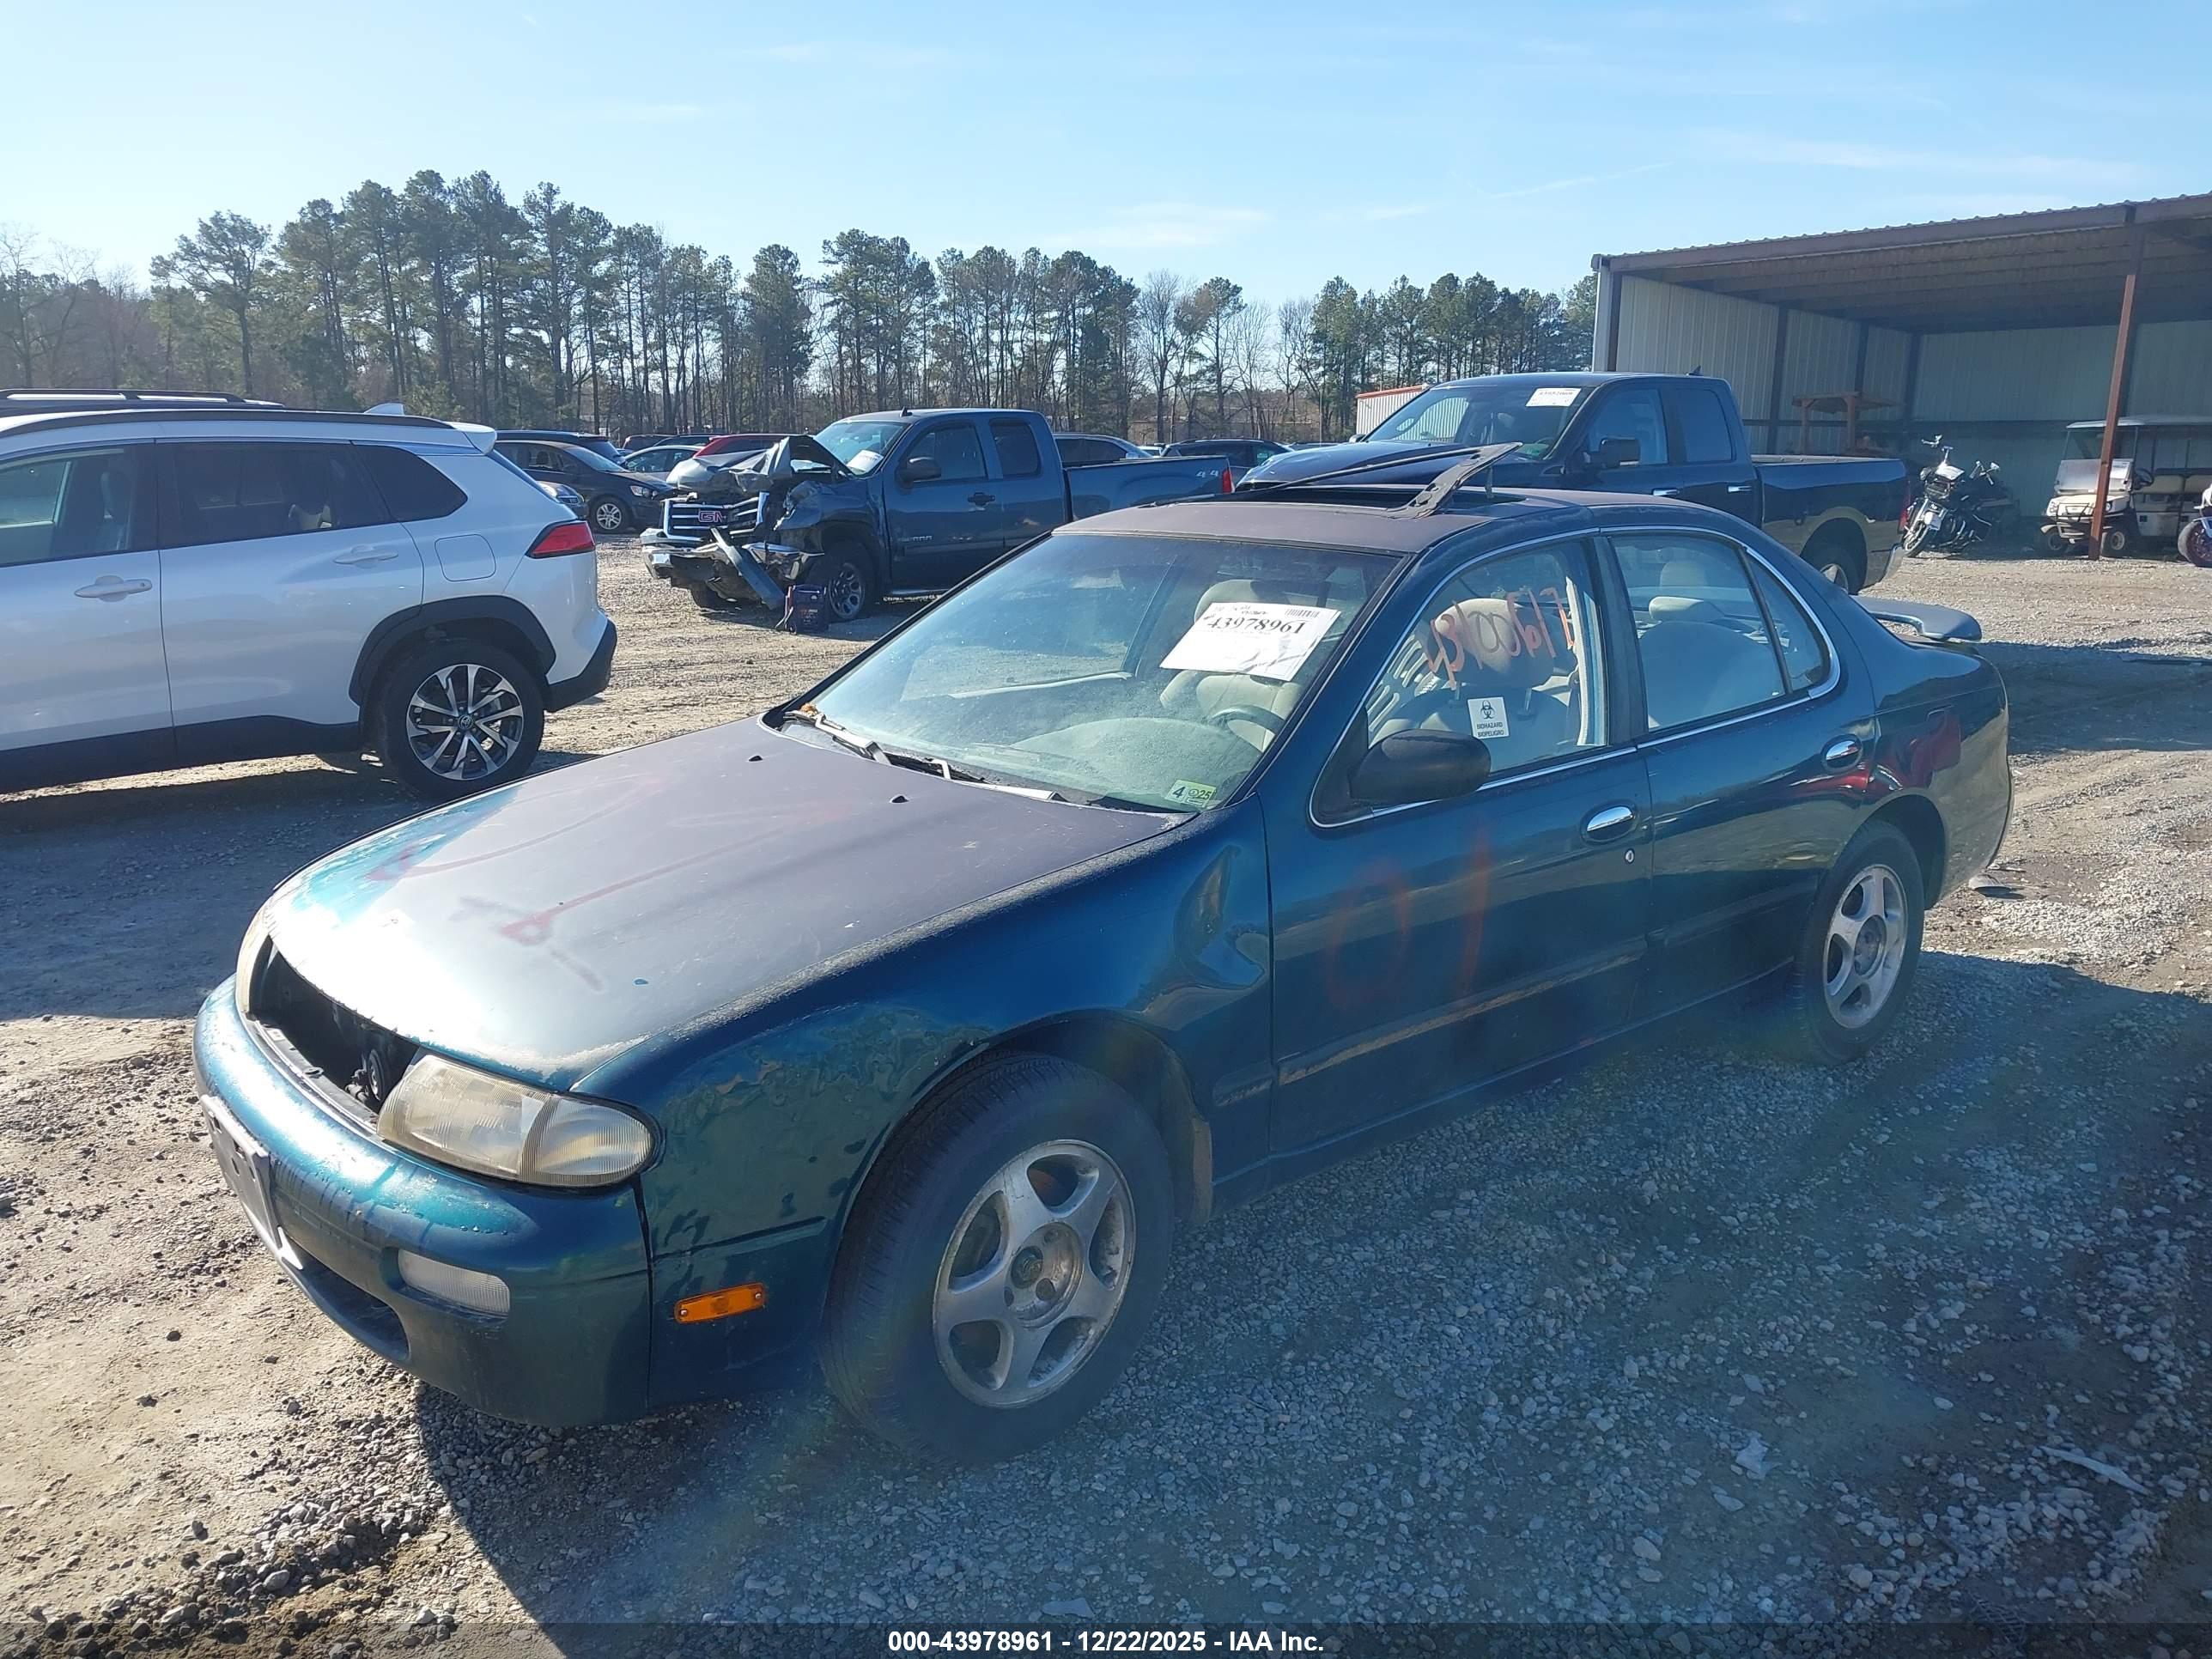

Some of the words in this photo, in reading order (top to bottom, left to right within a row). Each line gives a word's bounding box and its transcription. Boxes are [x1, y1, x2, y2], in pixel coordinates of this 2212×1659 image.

[1206, 617, 1310, 635] 43978961
[1476, 721, 1504, 730] BIOHAZARD
[1172, 786, 1186, 799] 4
[1197, 789, 1212, 800] 25
